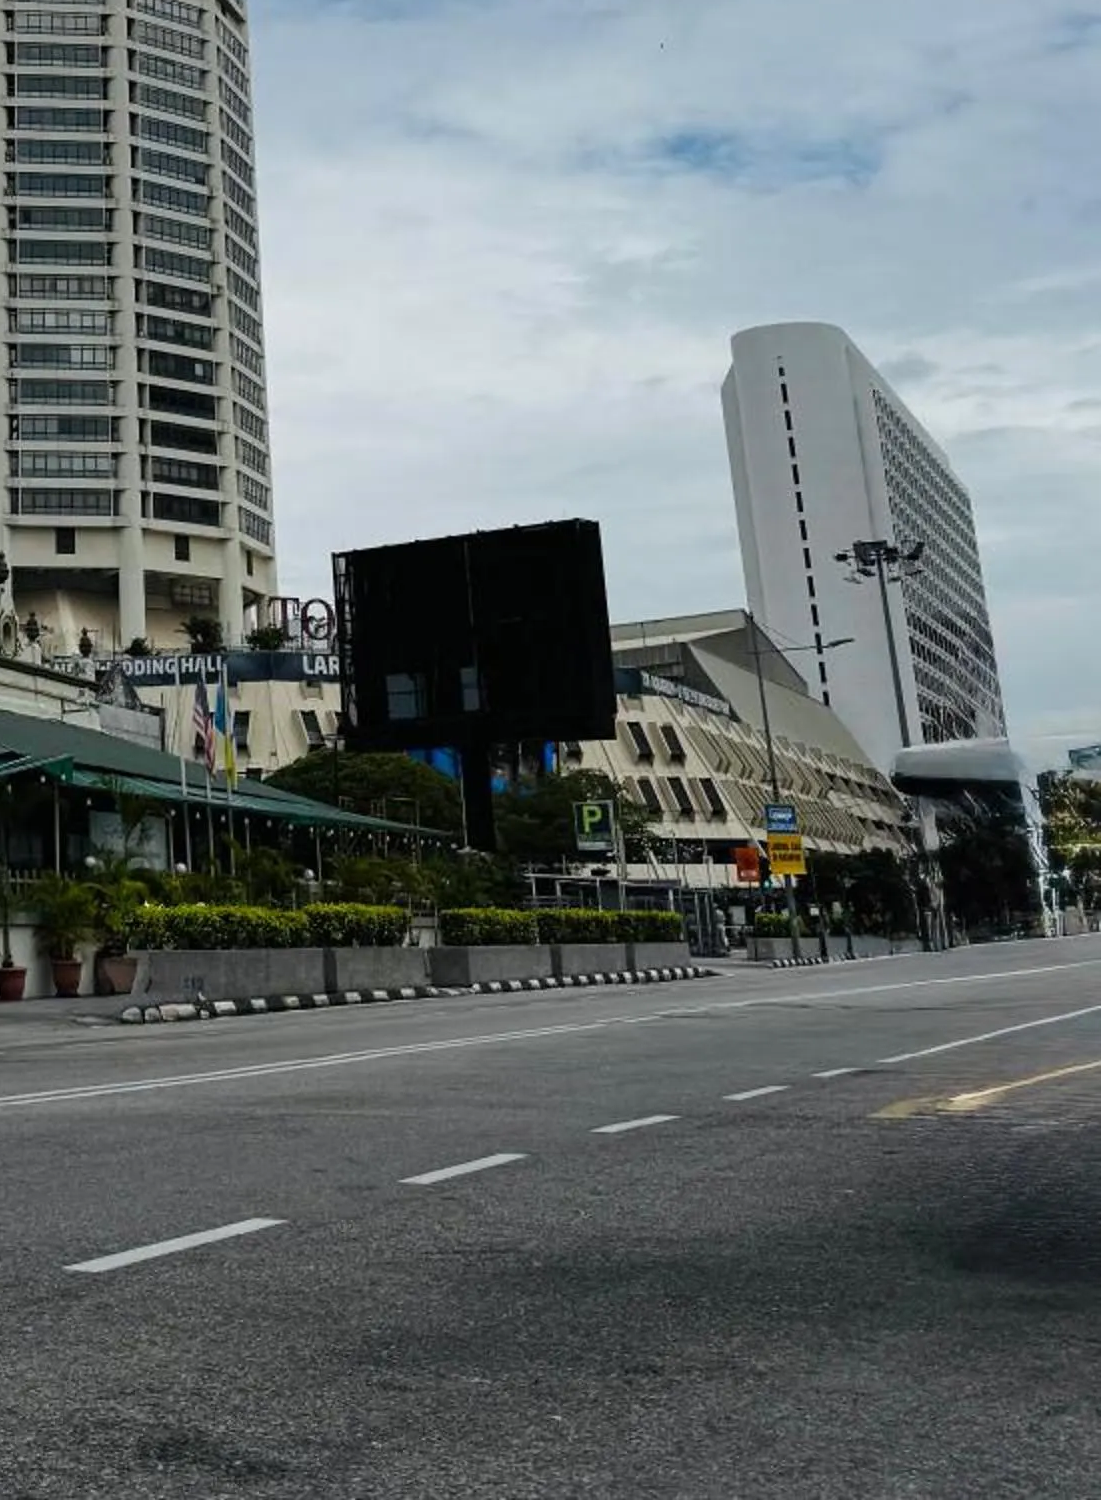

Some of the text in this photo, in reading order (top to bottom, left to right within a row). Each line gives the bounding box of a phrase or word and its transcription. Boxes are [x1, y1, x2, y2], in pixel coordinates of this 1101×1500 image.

[94, 658, 176, 677] WDDING
[179, 654, 222, 674] HALL
[582, 805, 603, 834] P
